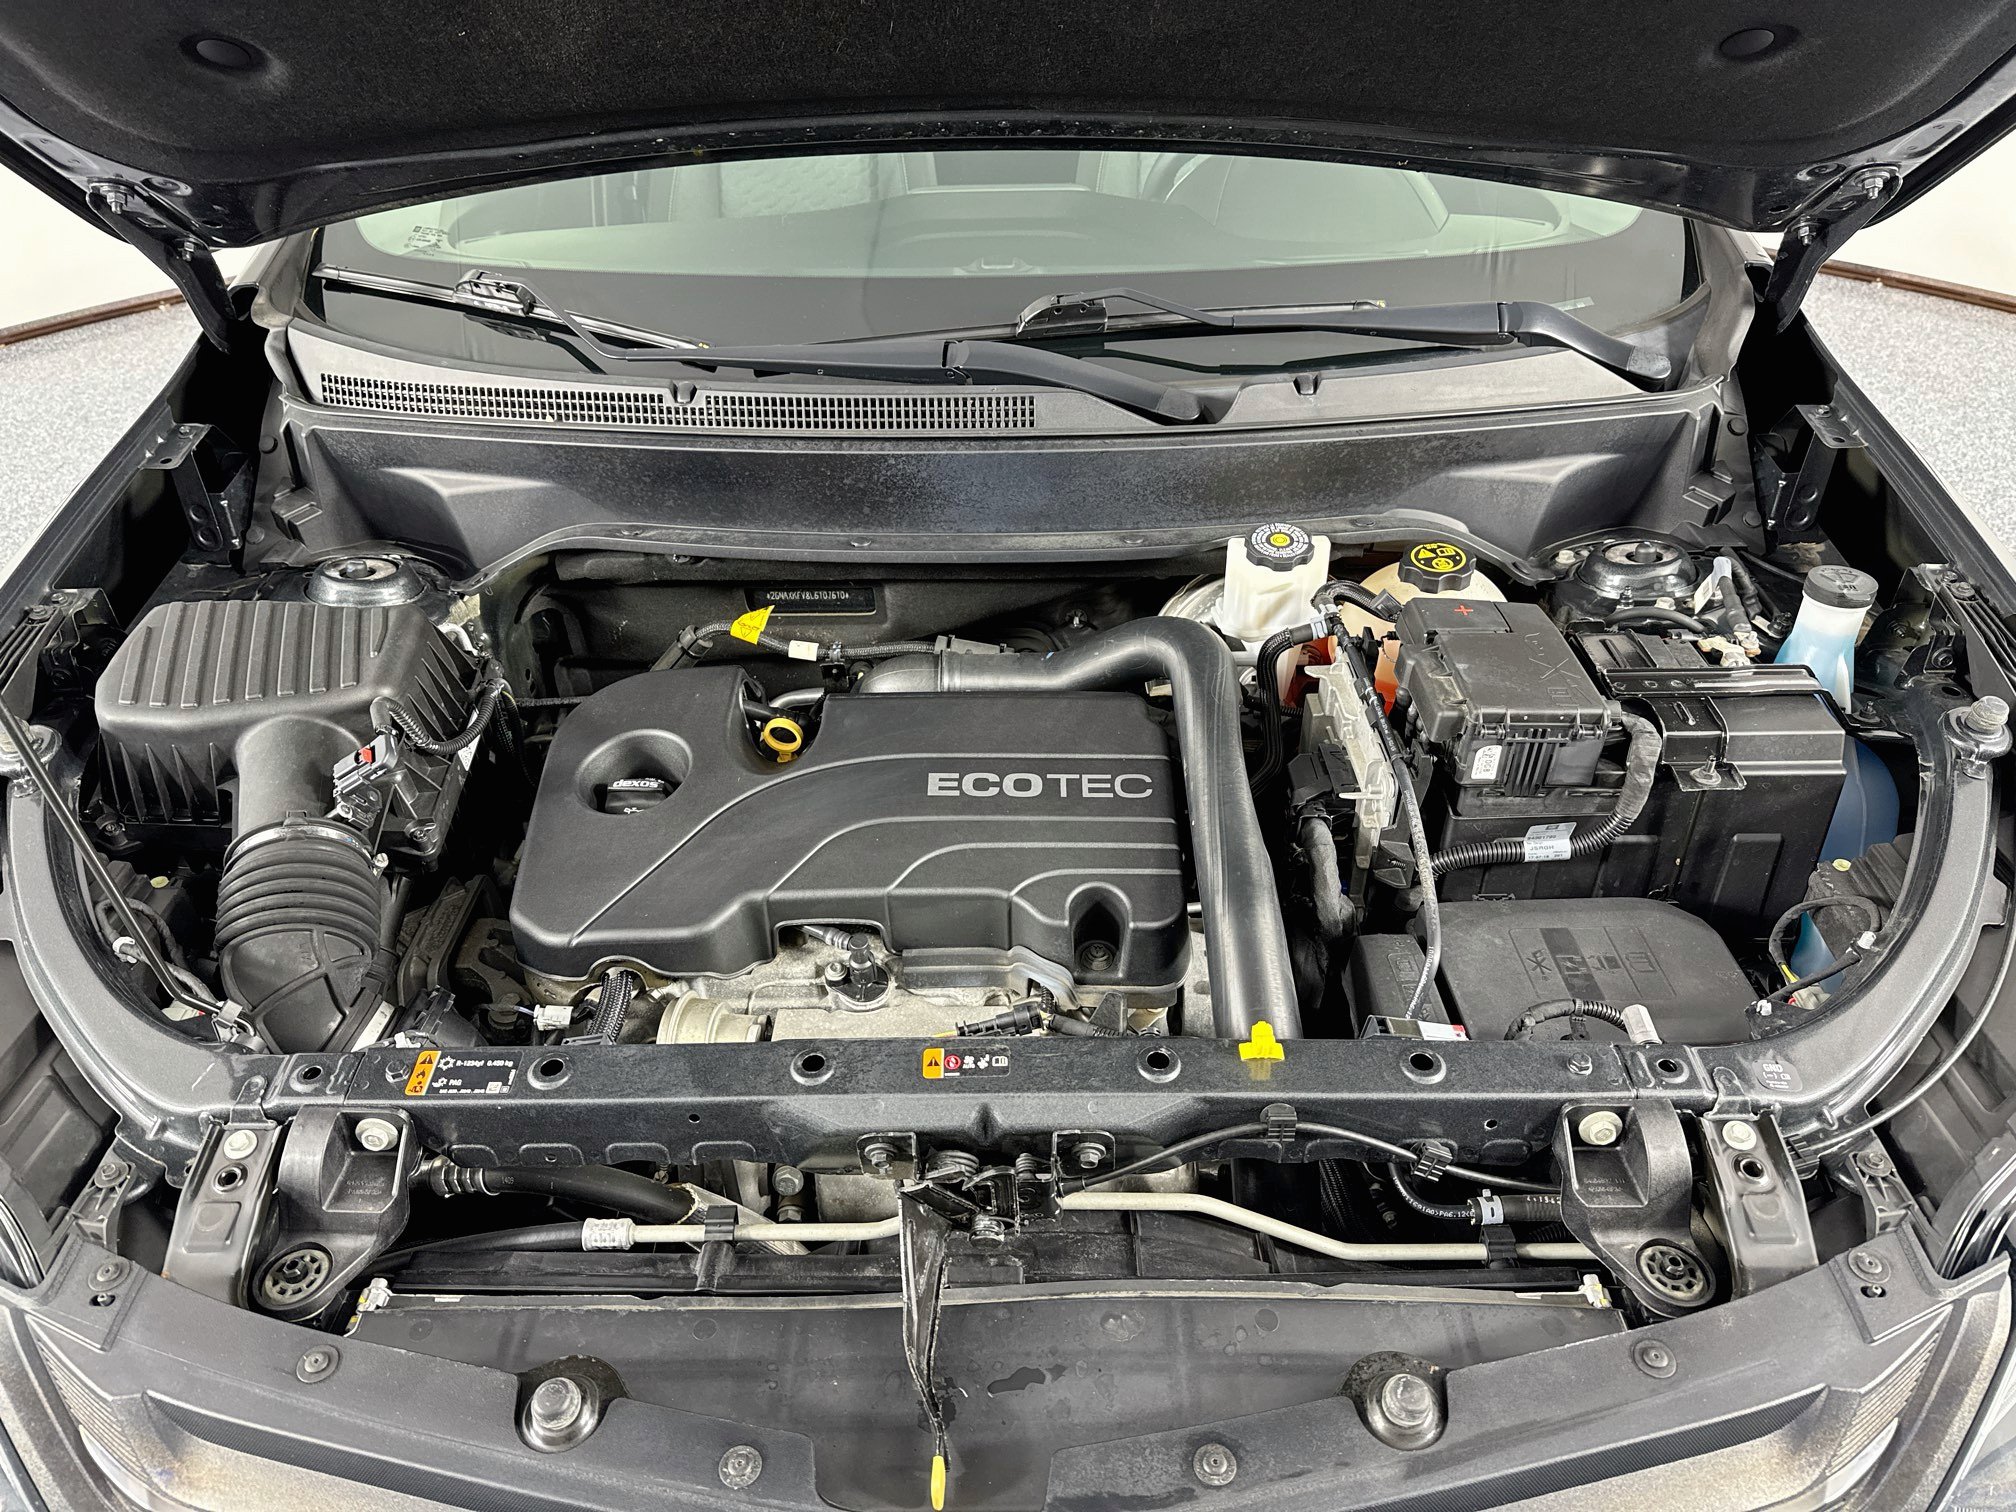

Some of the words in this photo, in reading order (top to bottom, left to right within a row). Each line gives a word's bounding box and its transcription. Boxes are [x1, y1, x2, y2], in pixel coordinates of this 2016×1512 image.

[612, 778, 659, 788] dexos
[926, 771, 1154, 799] ECOTEC
[504, 1060, 514, 1068] kg
[1762, 1063, 1784, 1073] GND
